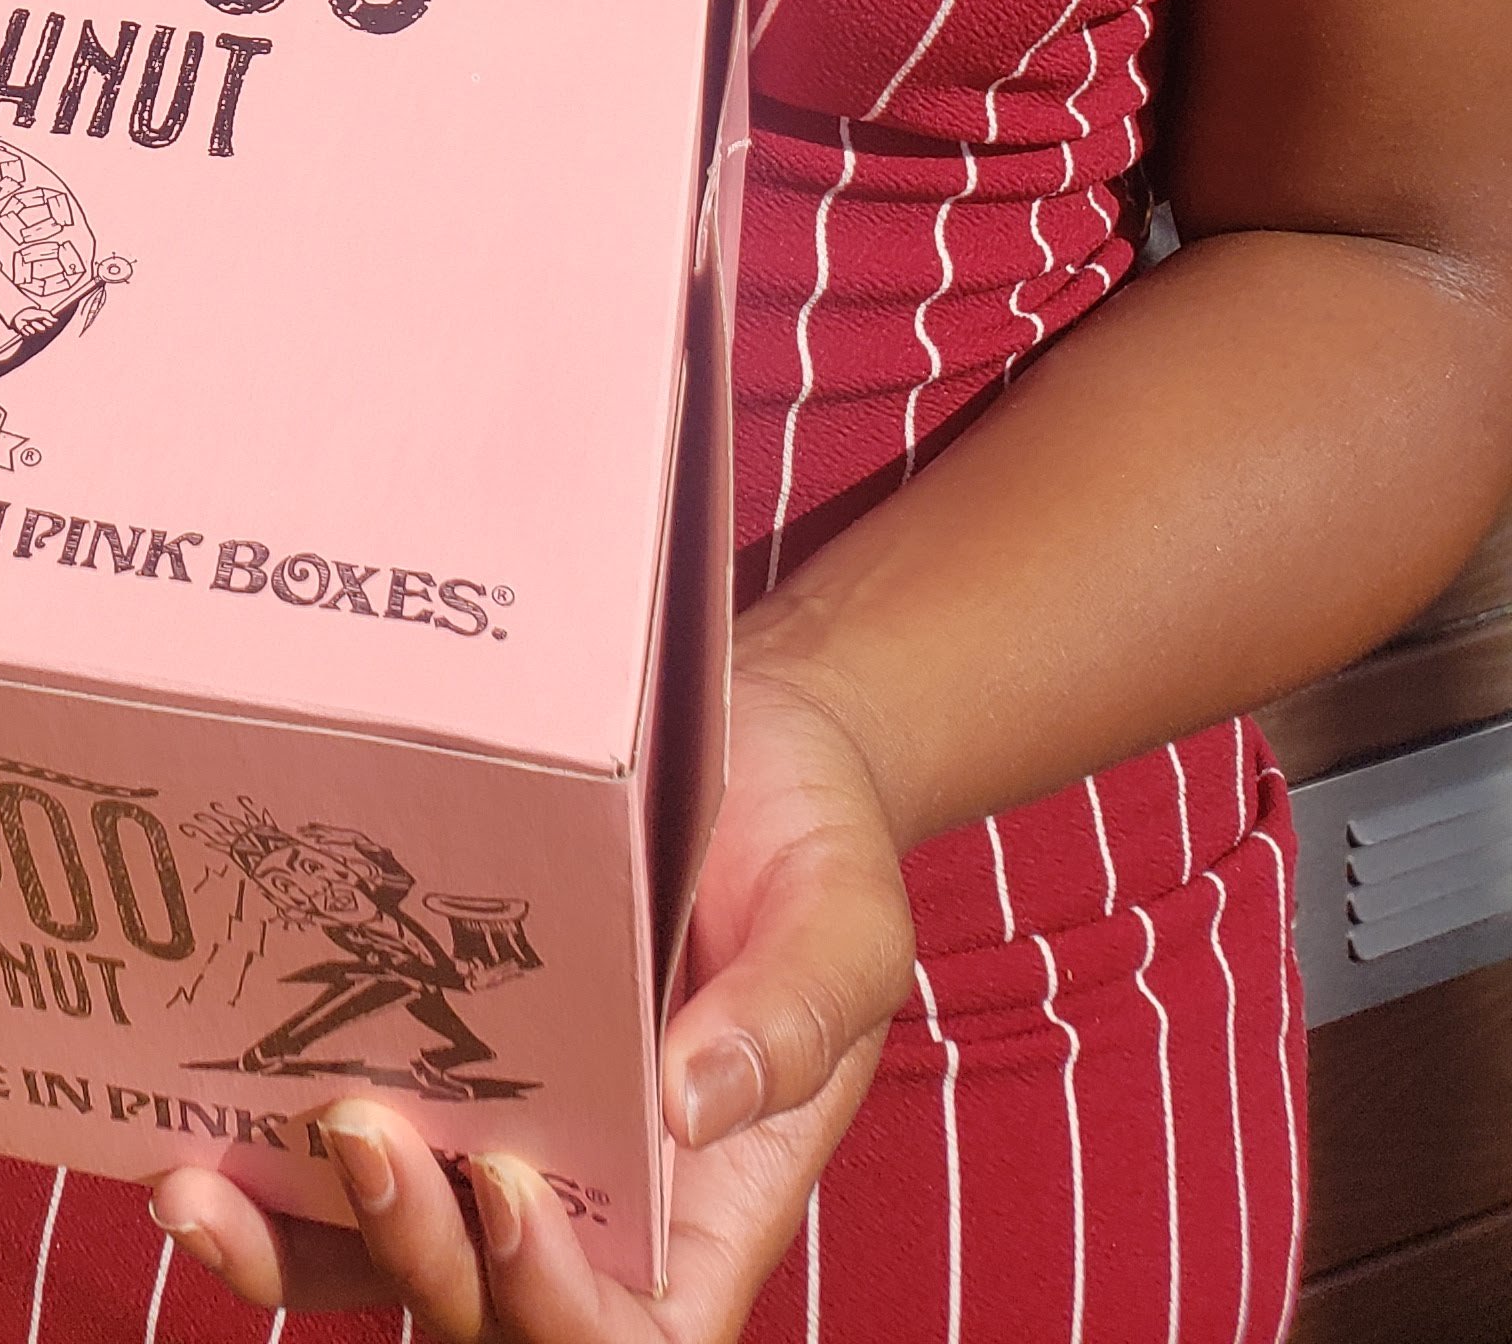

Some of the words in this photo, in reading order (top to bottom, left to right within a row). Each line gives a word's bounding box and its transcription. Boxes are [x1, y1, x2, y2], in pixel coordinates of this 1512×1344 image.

[13, 506, 204, 584] PINK
[20, 1068, 94, 1116] IN
[104, 1081, 290, 1152] PINK
